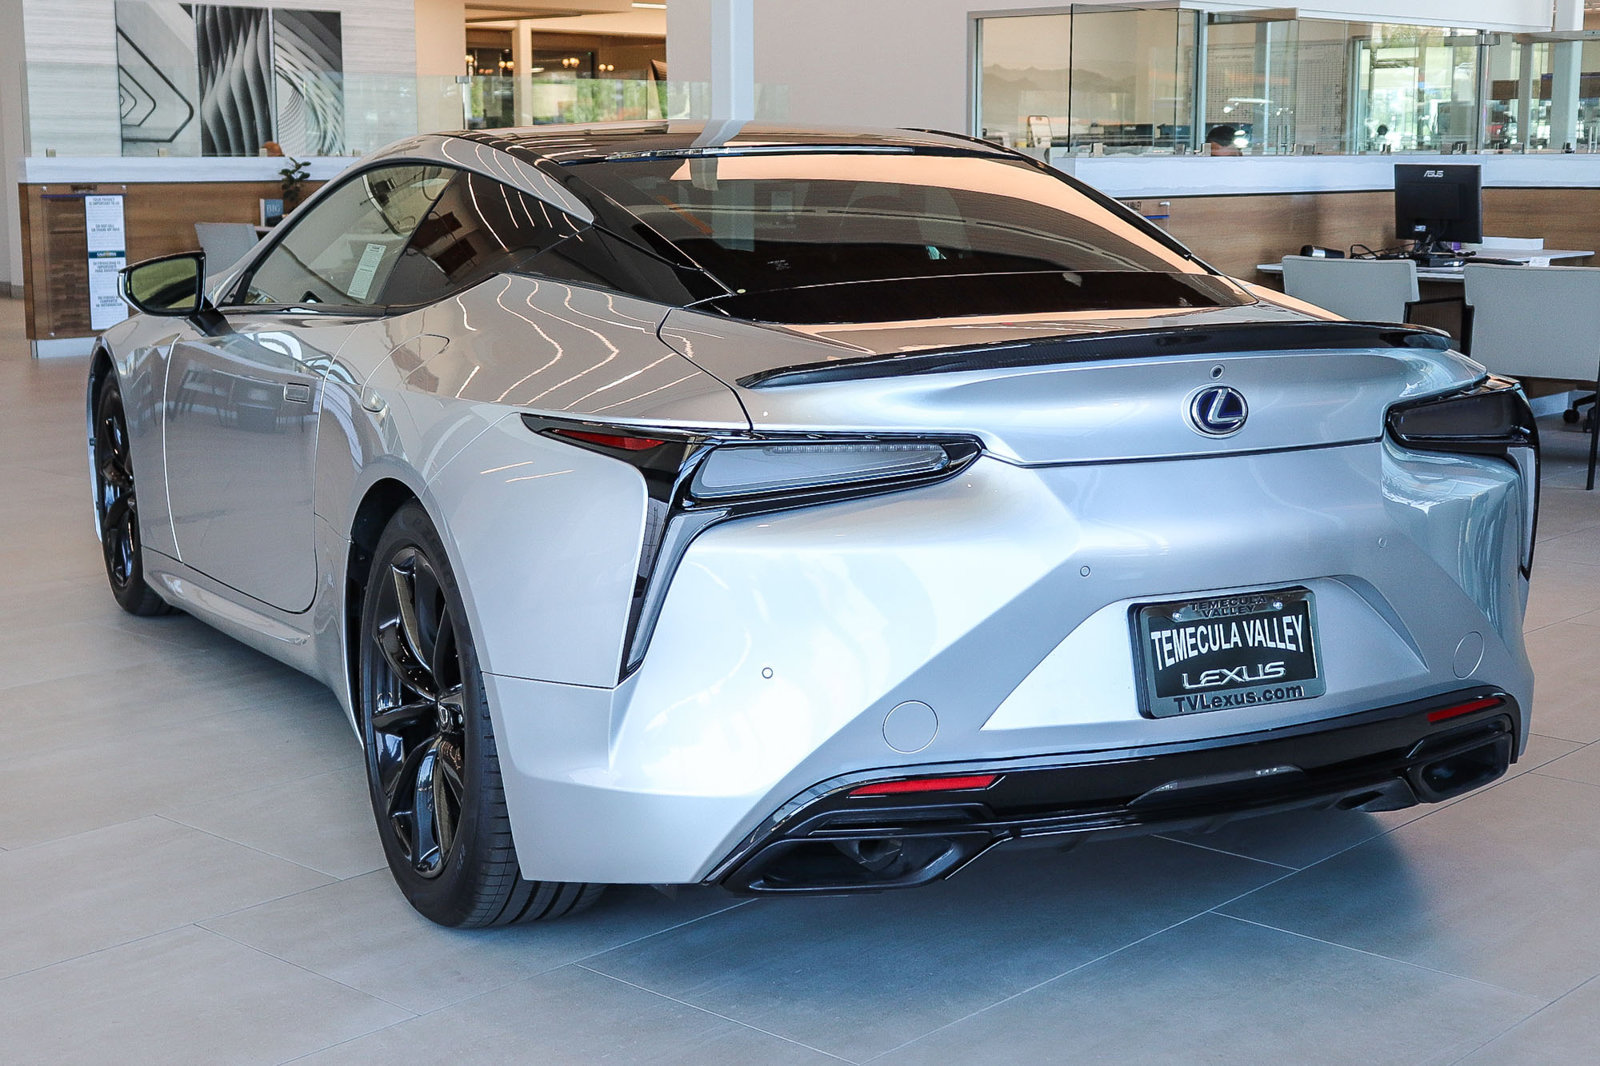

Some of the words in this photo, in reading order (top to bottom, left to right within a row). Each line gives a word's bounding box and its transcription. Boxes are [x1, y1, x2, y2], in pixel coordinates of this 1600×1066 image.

[1423, 170, 1444, 178] ASUS
[1189, 595, 1268, 611] TEMECULA
[1201, 604, 1256, 618] VALLEY
[1150, 621, 1243, 671] TEMECULA
[1243, 614, 1304, 653] VALLEY
[1182, 661, 1287, 690] LEXUS
[1173, 684, 1305, 713] TVLexus.com
